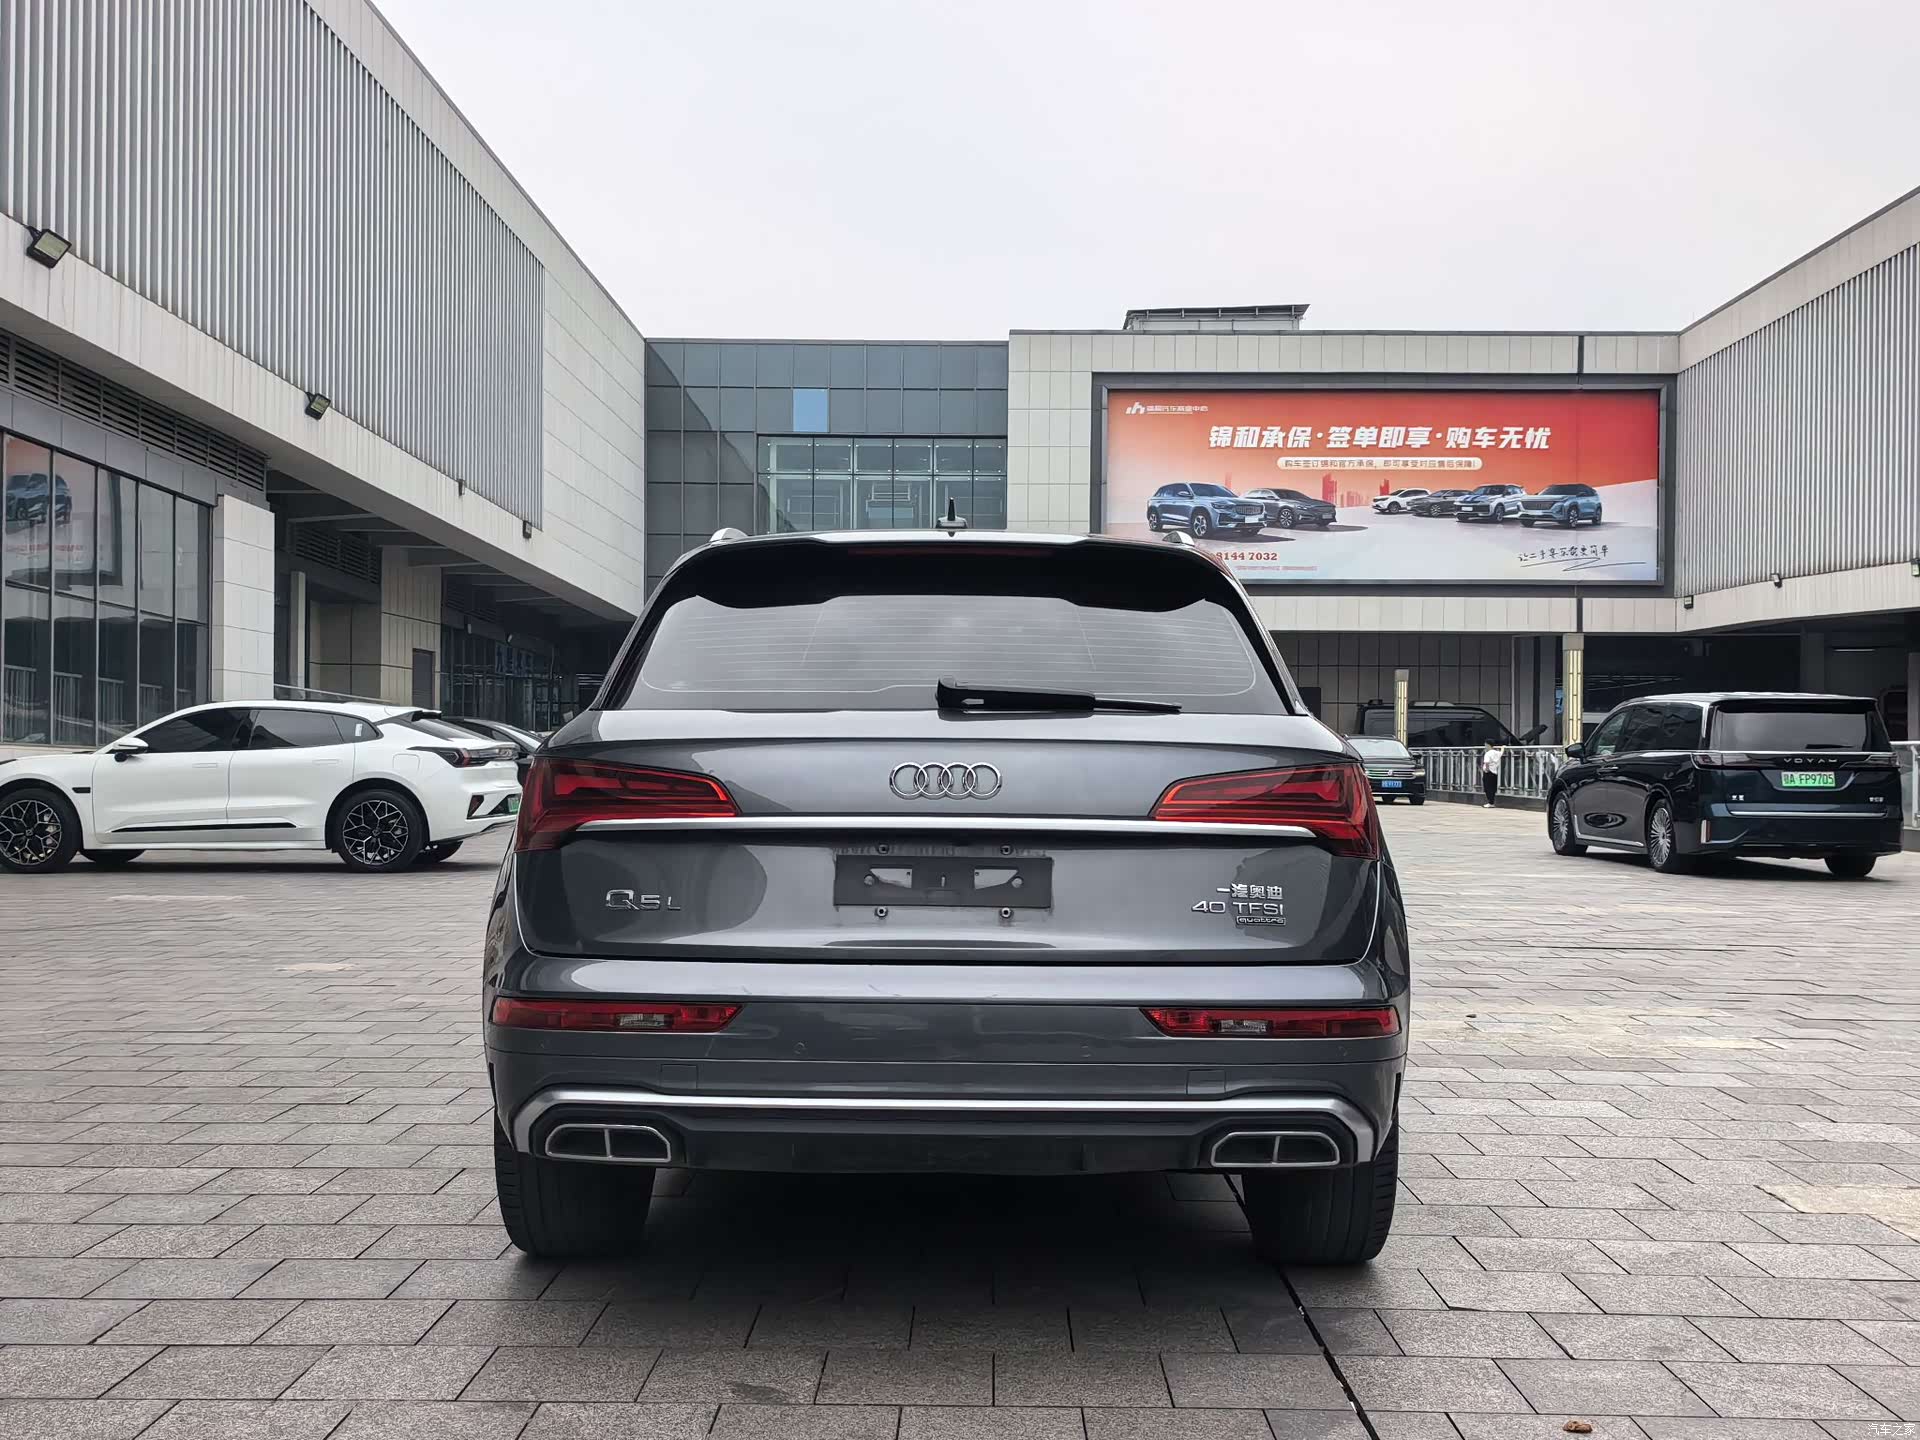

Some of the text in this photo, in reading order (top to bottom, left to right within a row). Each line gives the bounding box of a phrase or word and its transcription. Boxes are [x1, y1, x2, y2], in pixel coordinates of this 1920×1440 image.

[1248, 552, 1278, 561] 7032
[1216, 883, 1284, 900] 一汽奥迪
[1191, 900, 1284, 916] 40 TFSI
[1238, 916, 1285, 924] quattro
